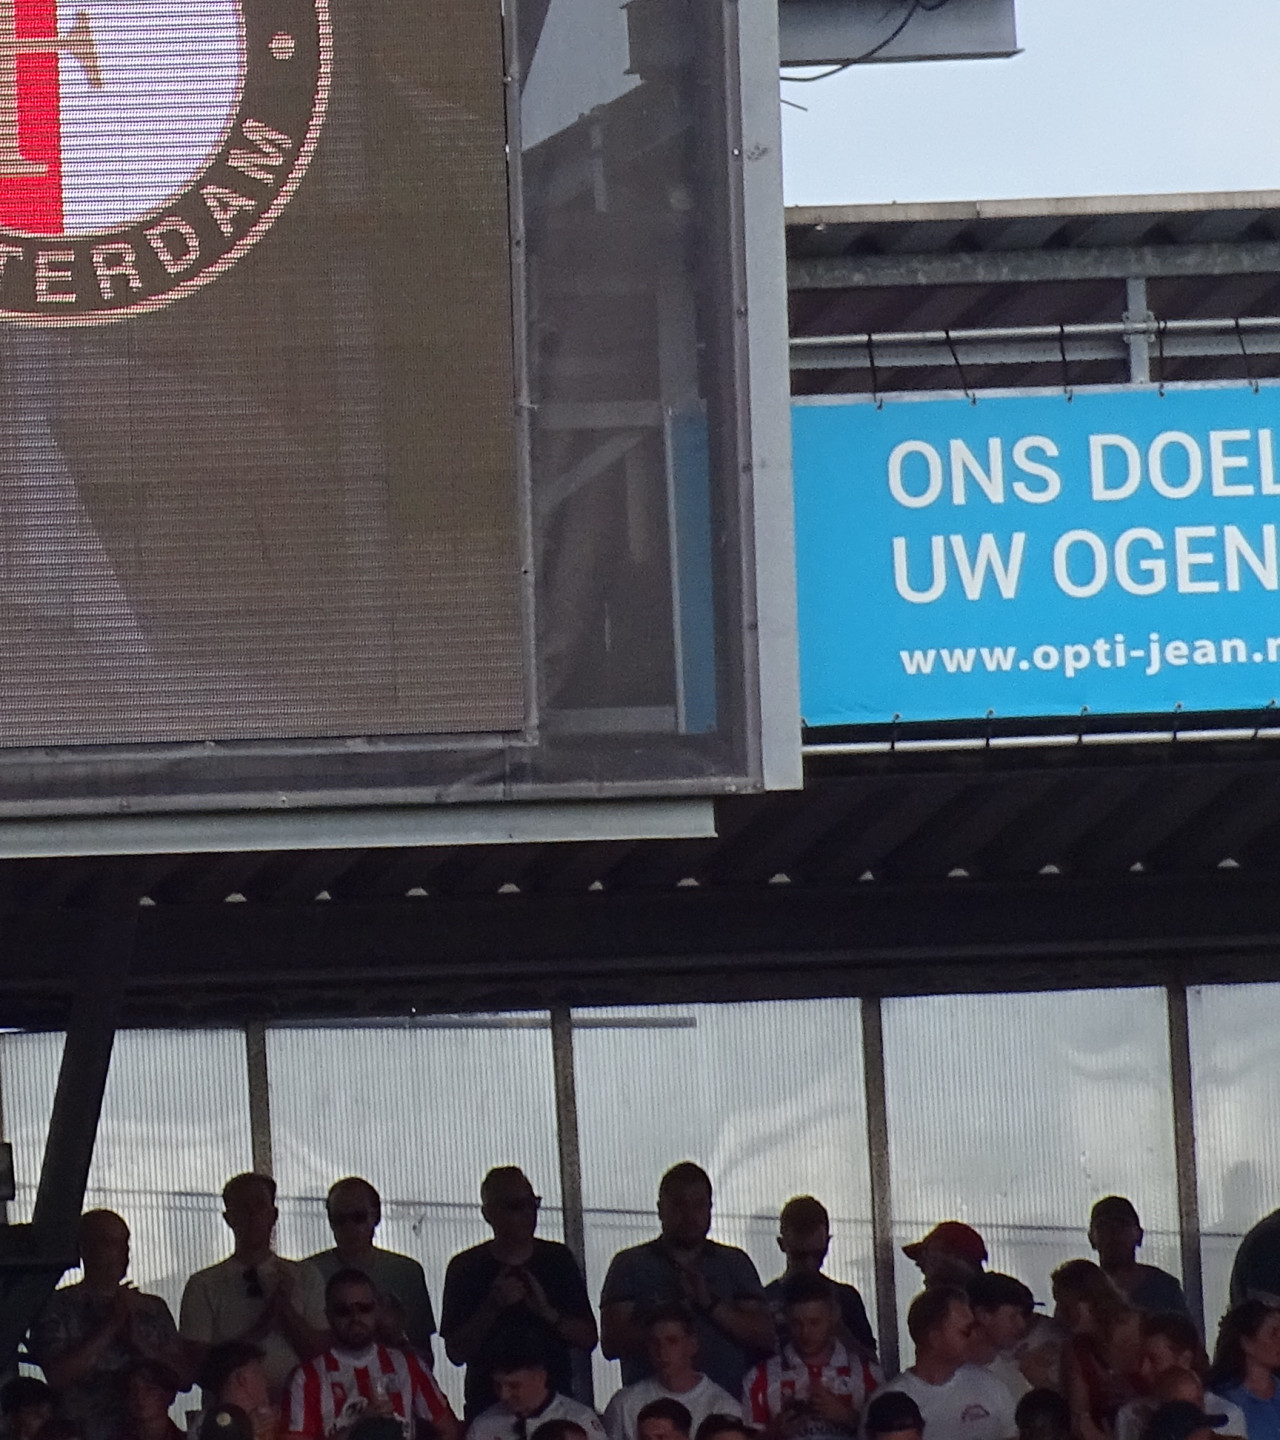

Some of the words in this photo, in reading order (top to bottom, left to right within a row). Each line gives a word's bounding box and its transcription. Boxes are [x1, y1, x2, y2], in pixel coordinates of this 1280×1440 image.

[887, 434, 1063, 509] ONS
[1087, 427, 1280, 502] DOEL
[892, 530, 1027, 604] UW
[1052, 523, 1279, 599] OGEN
